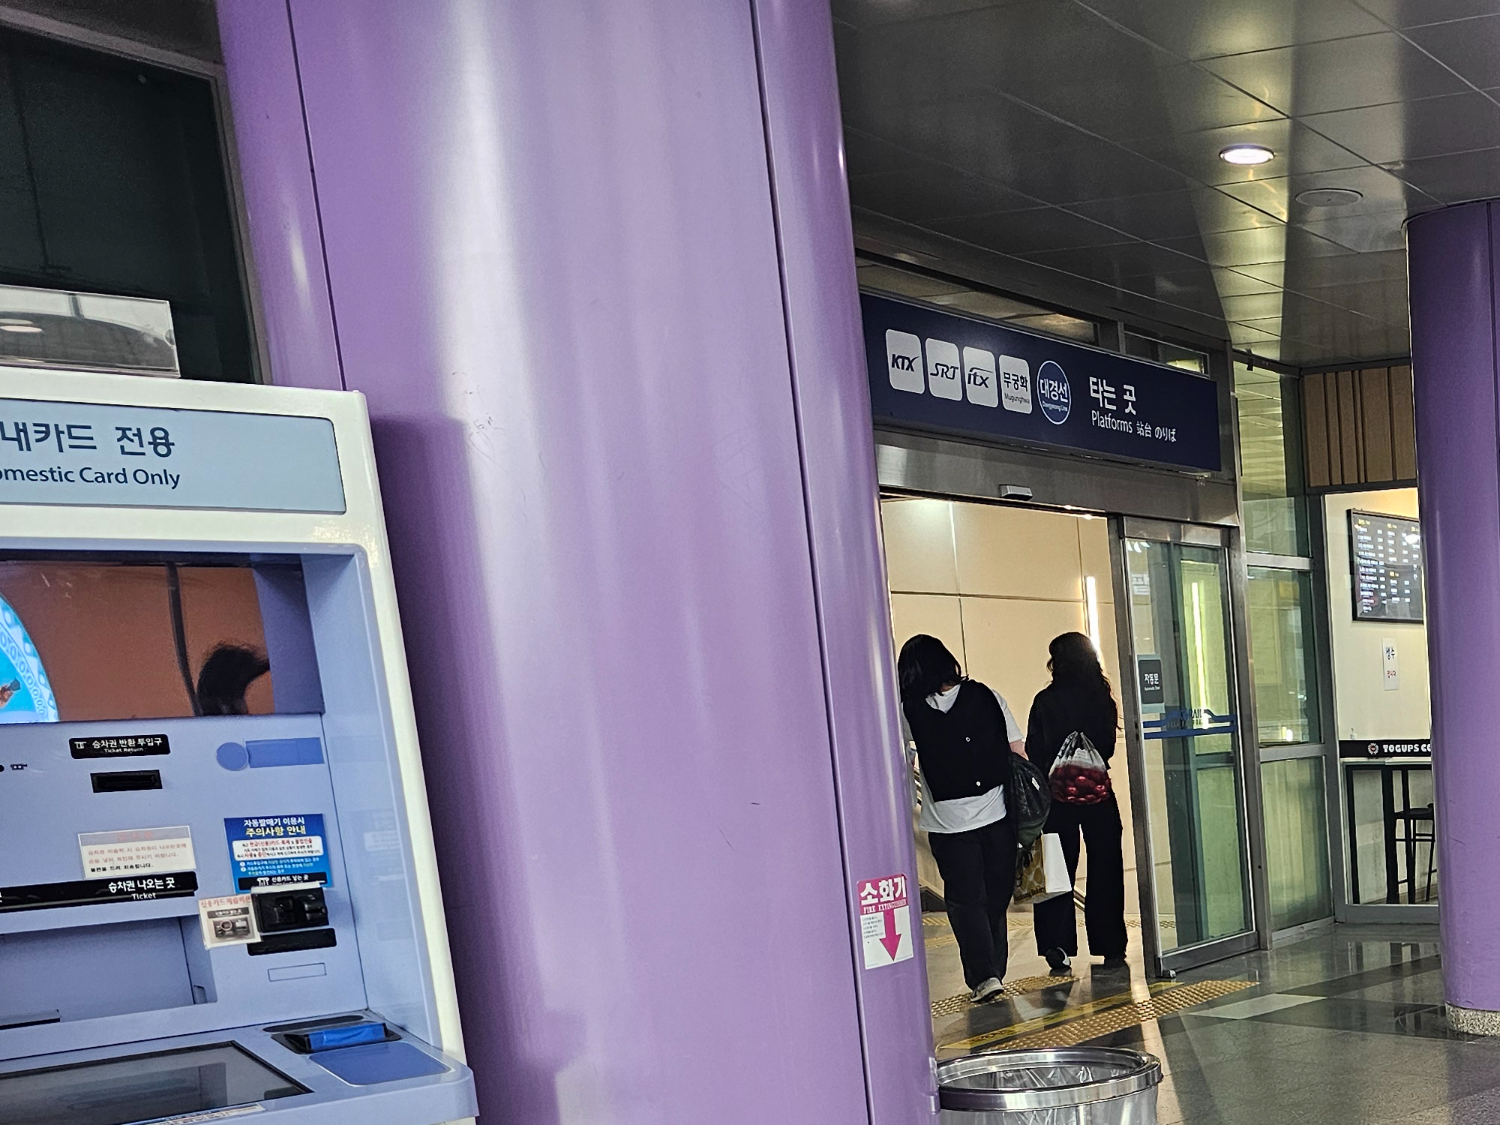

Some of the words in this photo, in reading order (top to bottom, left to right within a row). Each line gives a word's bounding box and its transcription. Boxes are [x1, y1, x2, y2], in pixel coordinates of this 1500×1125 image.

[891, 353, 920, 372] KTX
[930, 362, 959, 380] SRT
[1003, 371, 1029, 392] 무궁화
[1039, 378, 1068, 403] 대경선
[1004, 393, 1030, 405] Mugunghwa
[1089, 376, 1117, 411] 타는
[1123, 384, 1137, 415] 곳
[1091, 410, 1133, 434] Platforms
[1136, 421, 1152, 438] 站台
[1154, 426, 1176, 442] のりば
[115, 426, 175, 458] 전용
[79, 467, 128, 484] Card
[133, 469, 180, 490] Only
[92, 740, 117, 749] 승차권
[118, 739, 135, 748] 반환
[137, 738, 162, 747] 투입구
[1383, 744, 1419, 752] TOGUPS
[245, 826, 284, 837] 주의사항
[286, 825, 306, 835] 안내
[108, 880, 136, 893] 승차권
[137, 878, 164, 890] 나오는
[165, 877, 176, 889] 곳
[860, 876, 907, 905] 소화기
[131, 892, 156, 900] Ticket
[864, 905, 876, 914] FIRE
